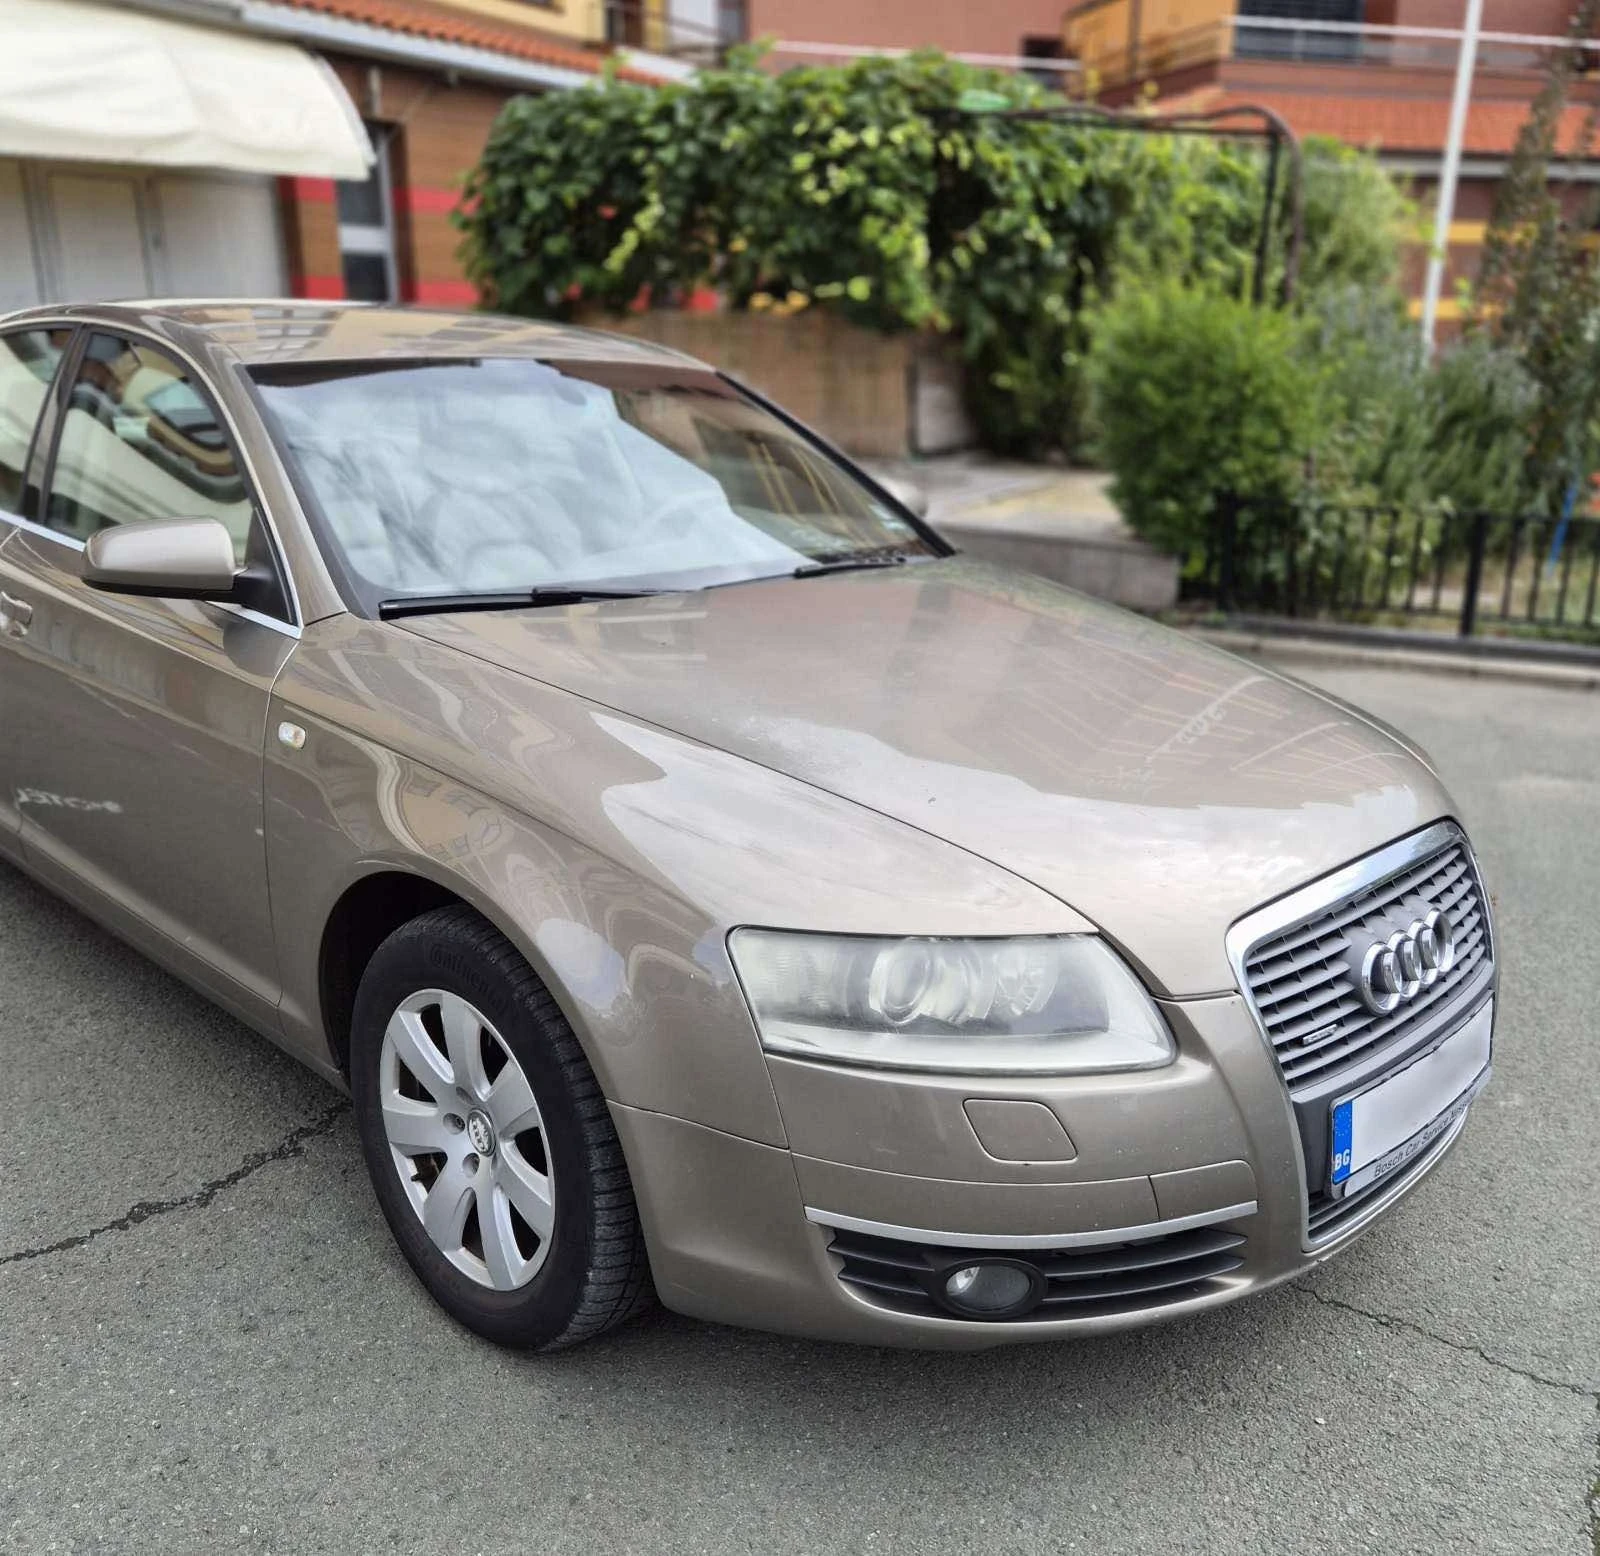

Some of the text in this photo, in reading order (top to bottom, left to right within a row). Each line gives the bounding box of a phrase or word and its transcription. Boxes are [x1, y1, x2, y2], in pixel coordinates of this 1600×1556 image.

[1334, 1149, 1350, 1171] BG
[1374, 1150, 1403, 1177] Bosch
[1405, 1139, 1421, 1156] Car
